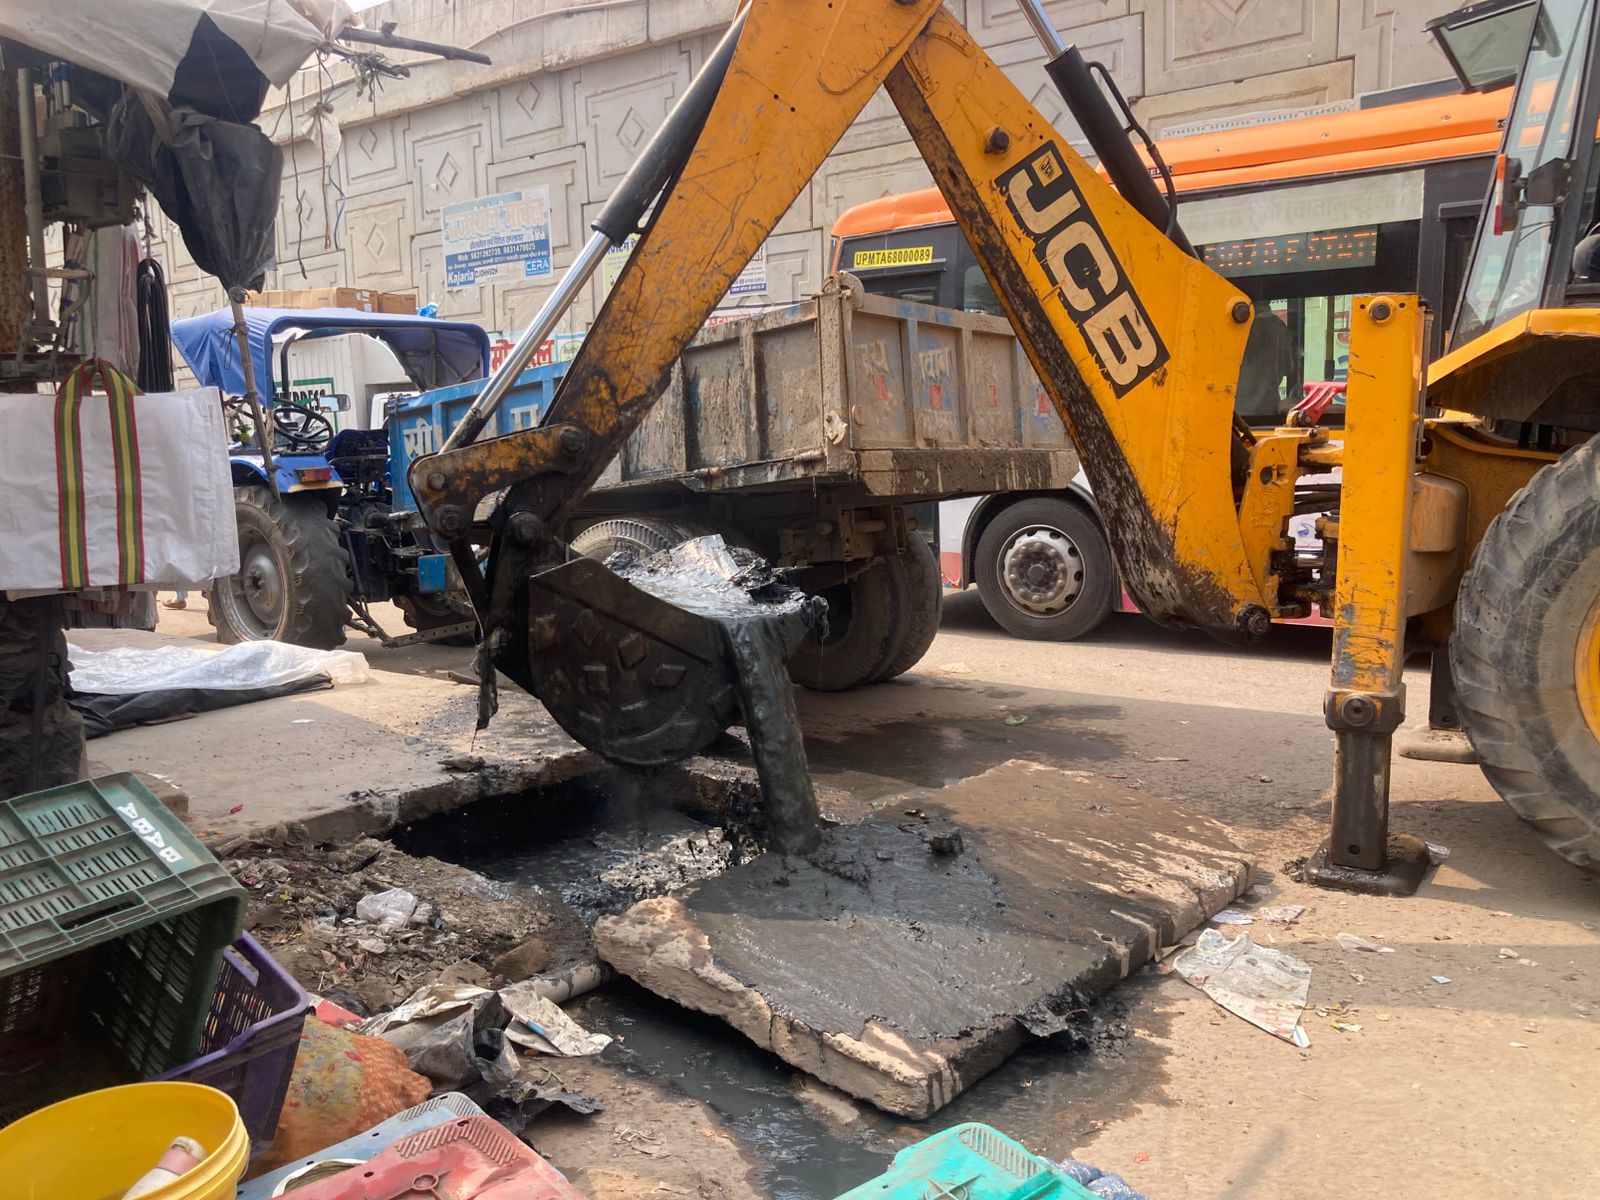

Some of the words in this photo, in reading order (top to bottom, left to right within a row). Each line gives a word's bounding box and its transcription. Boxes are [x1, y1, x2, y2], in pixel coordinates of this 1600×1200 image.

[447, 269, 474, 286] Kajaria
[526, 258, 549, 271] CERA
[855, 248, 931, 266] UPMTA68000089
[1008, 168, 1158, 386] JCB
[116, 802, 184, 863] BABA
